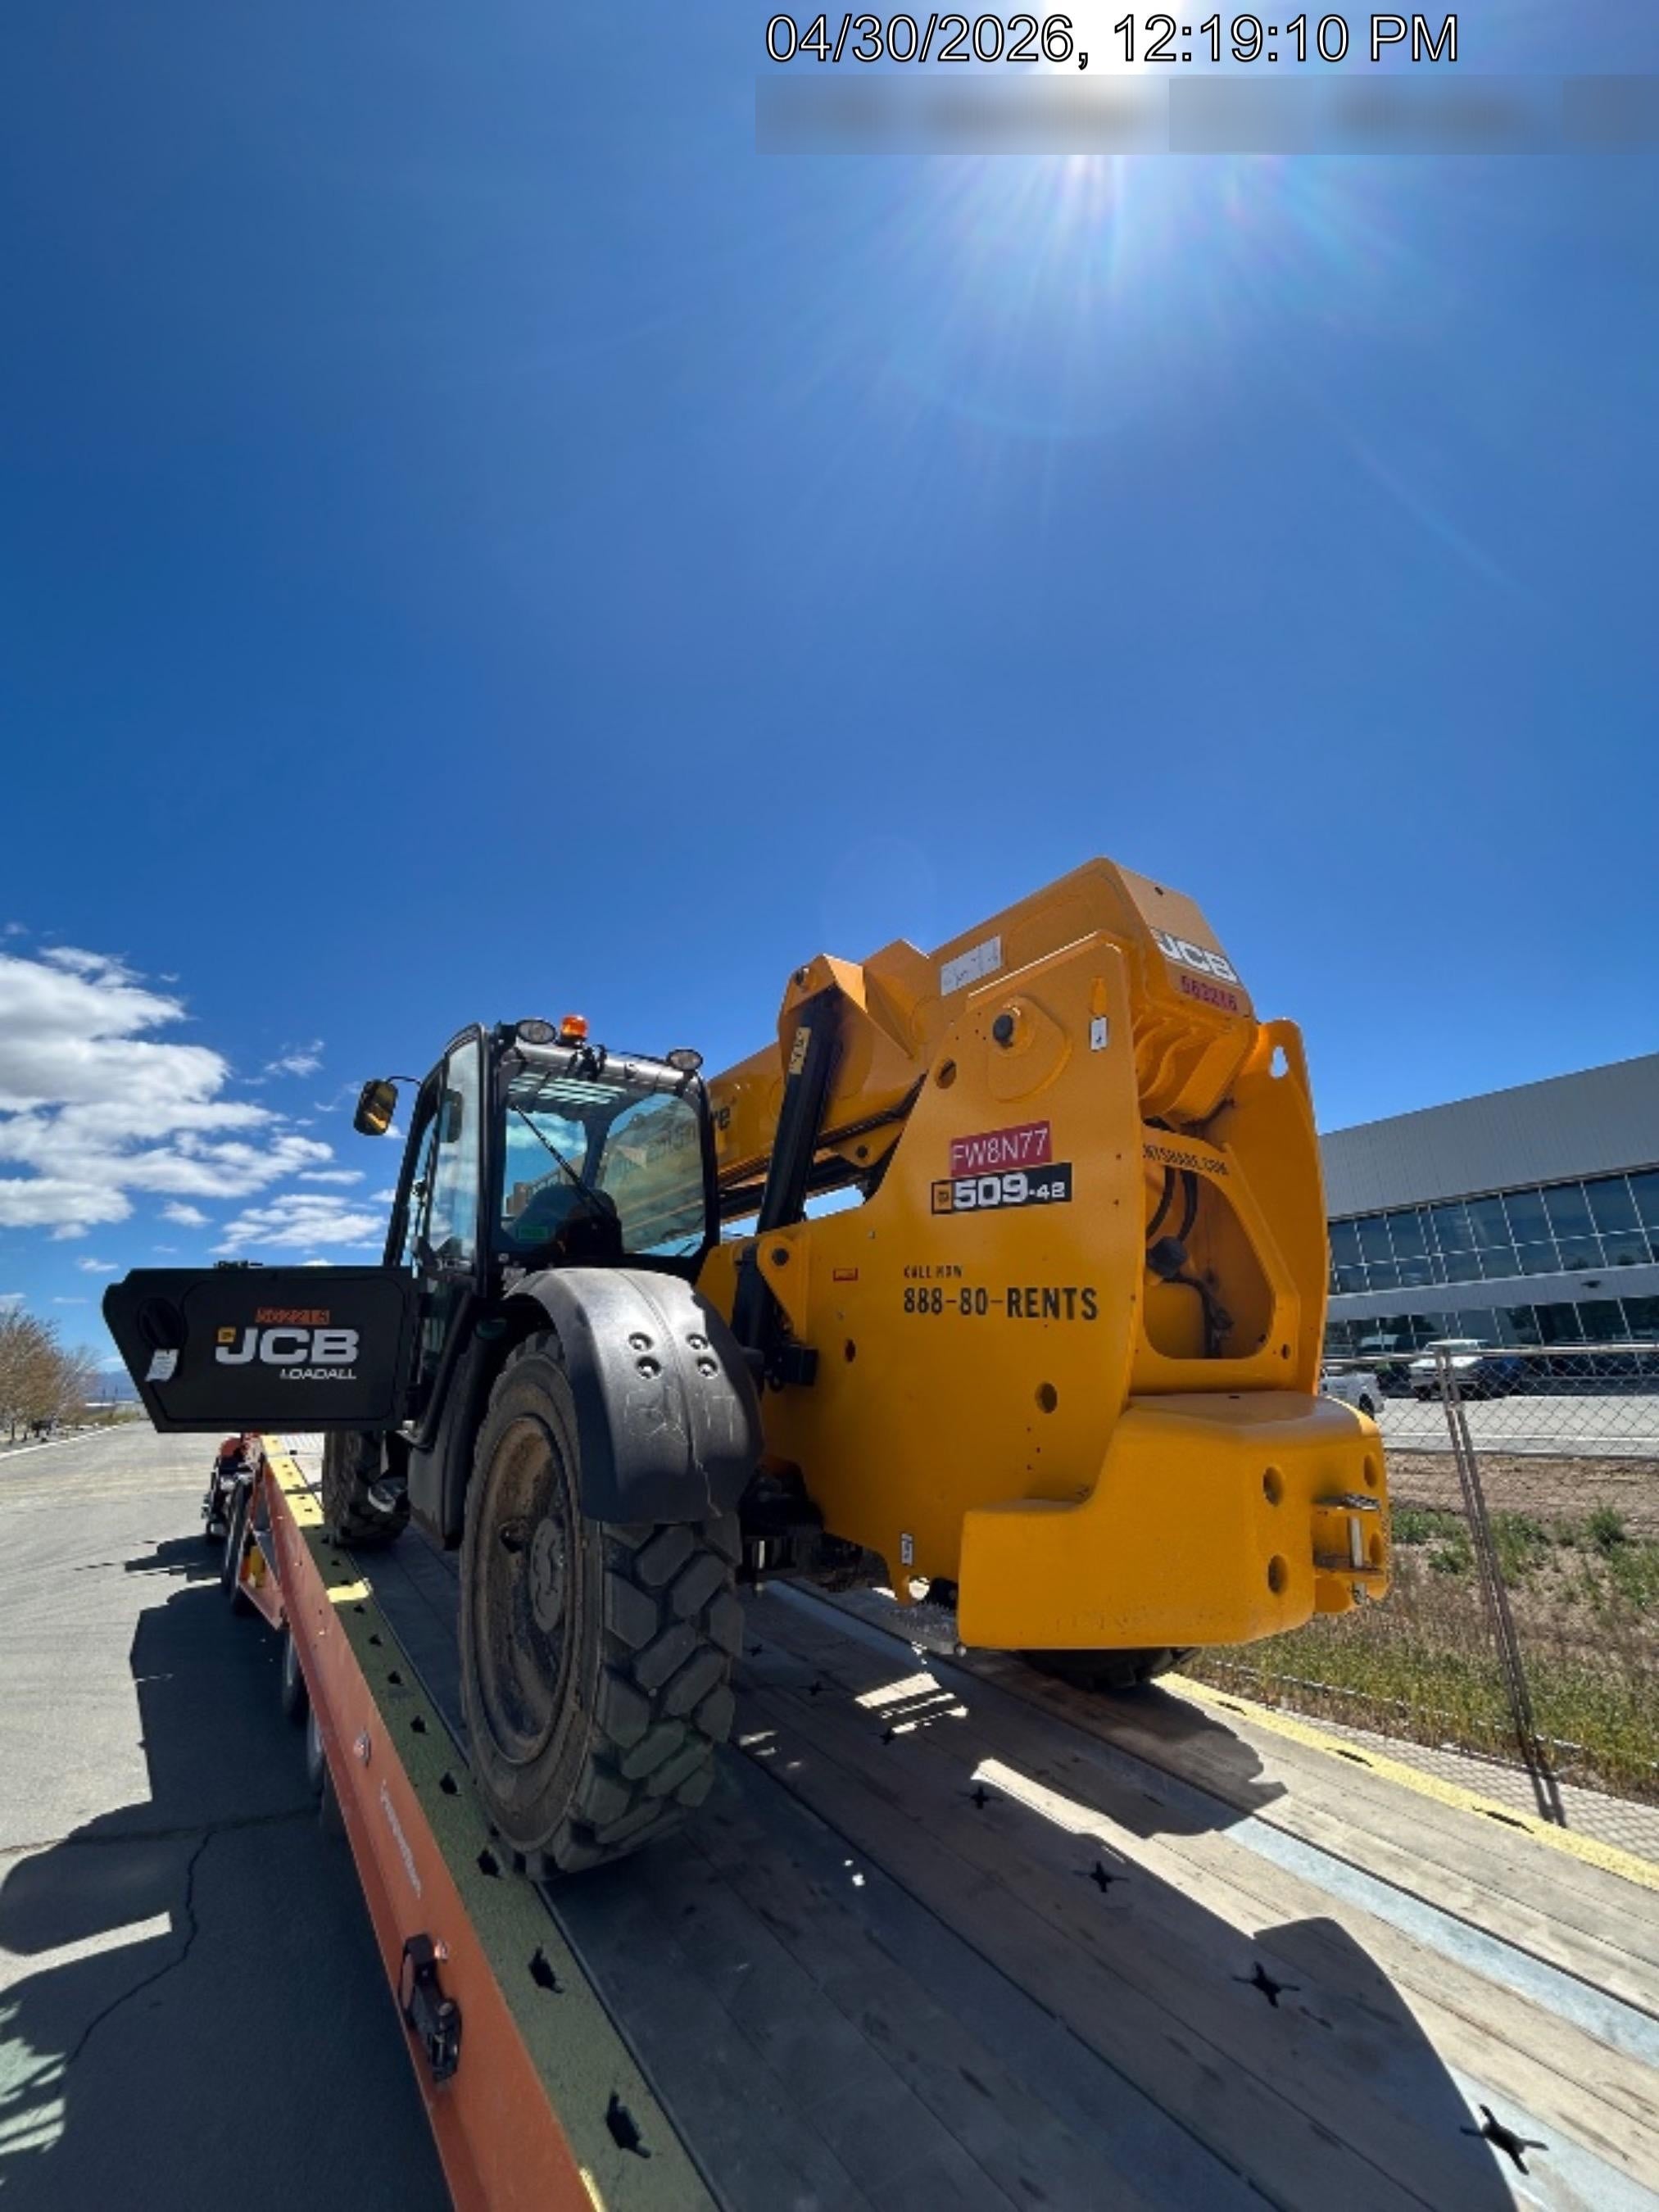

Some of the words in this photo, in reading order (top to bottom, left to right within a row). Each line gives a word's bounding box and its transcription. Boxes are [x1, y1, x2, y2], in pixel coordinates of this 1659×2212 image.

[1157, 933, 1238, 983] JCB
[953, 1127, 1048, 1169] FW8N77
[953, 1172, 1066, 1210] 509-42
[904, 1287, 1098, 1321] 888-80-RENTS
[215, 1326, 360, 1365] JCB
[279, 1367, 357, 1380] LOADALL
